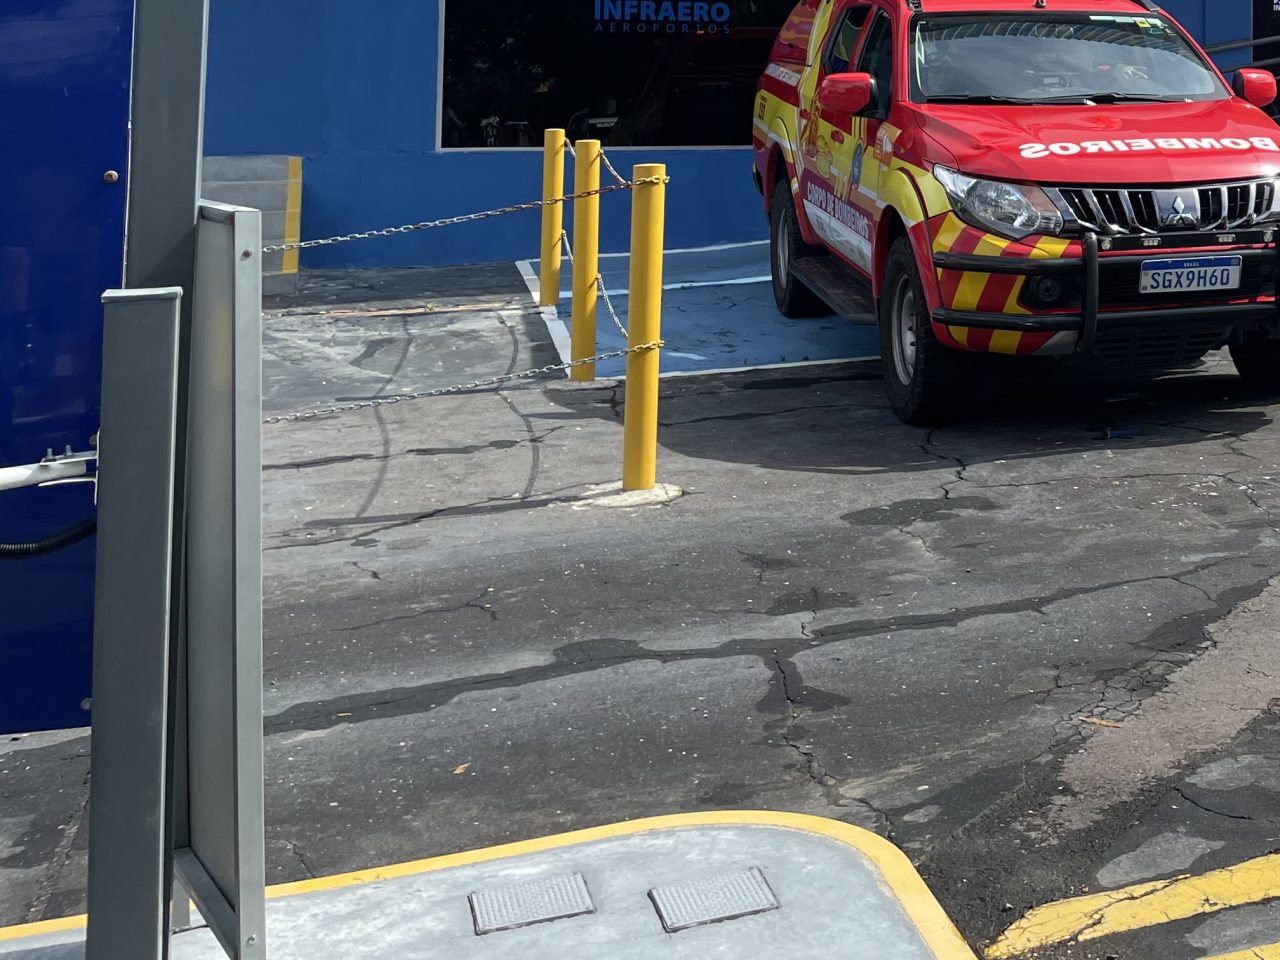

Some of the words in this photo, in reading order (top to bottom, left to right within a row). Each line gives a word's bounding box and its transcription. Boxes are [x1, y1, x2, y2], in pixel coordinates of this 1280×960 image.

[593, 0, 730, 22] INFRAERO
[594, 22, 730, 34] AEROPORTOS
[1150, 268, 1230, 290] SGX9H60
